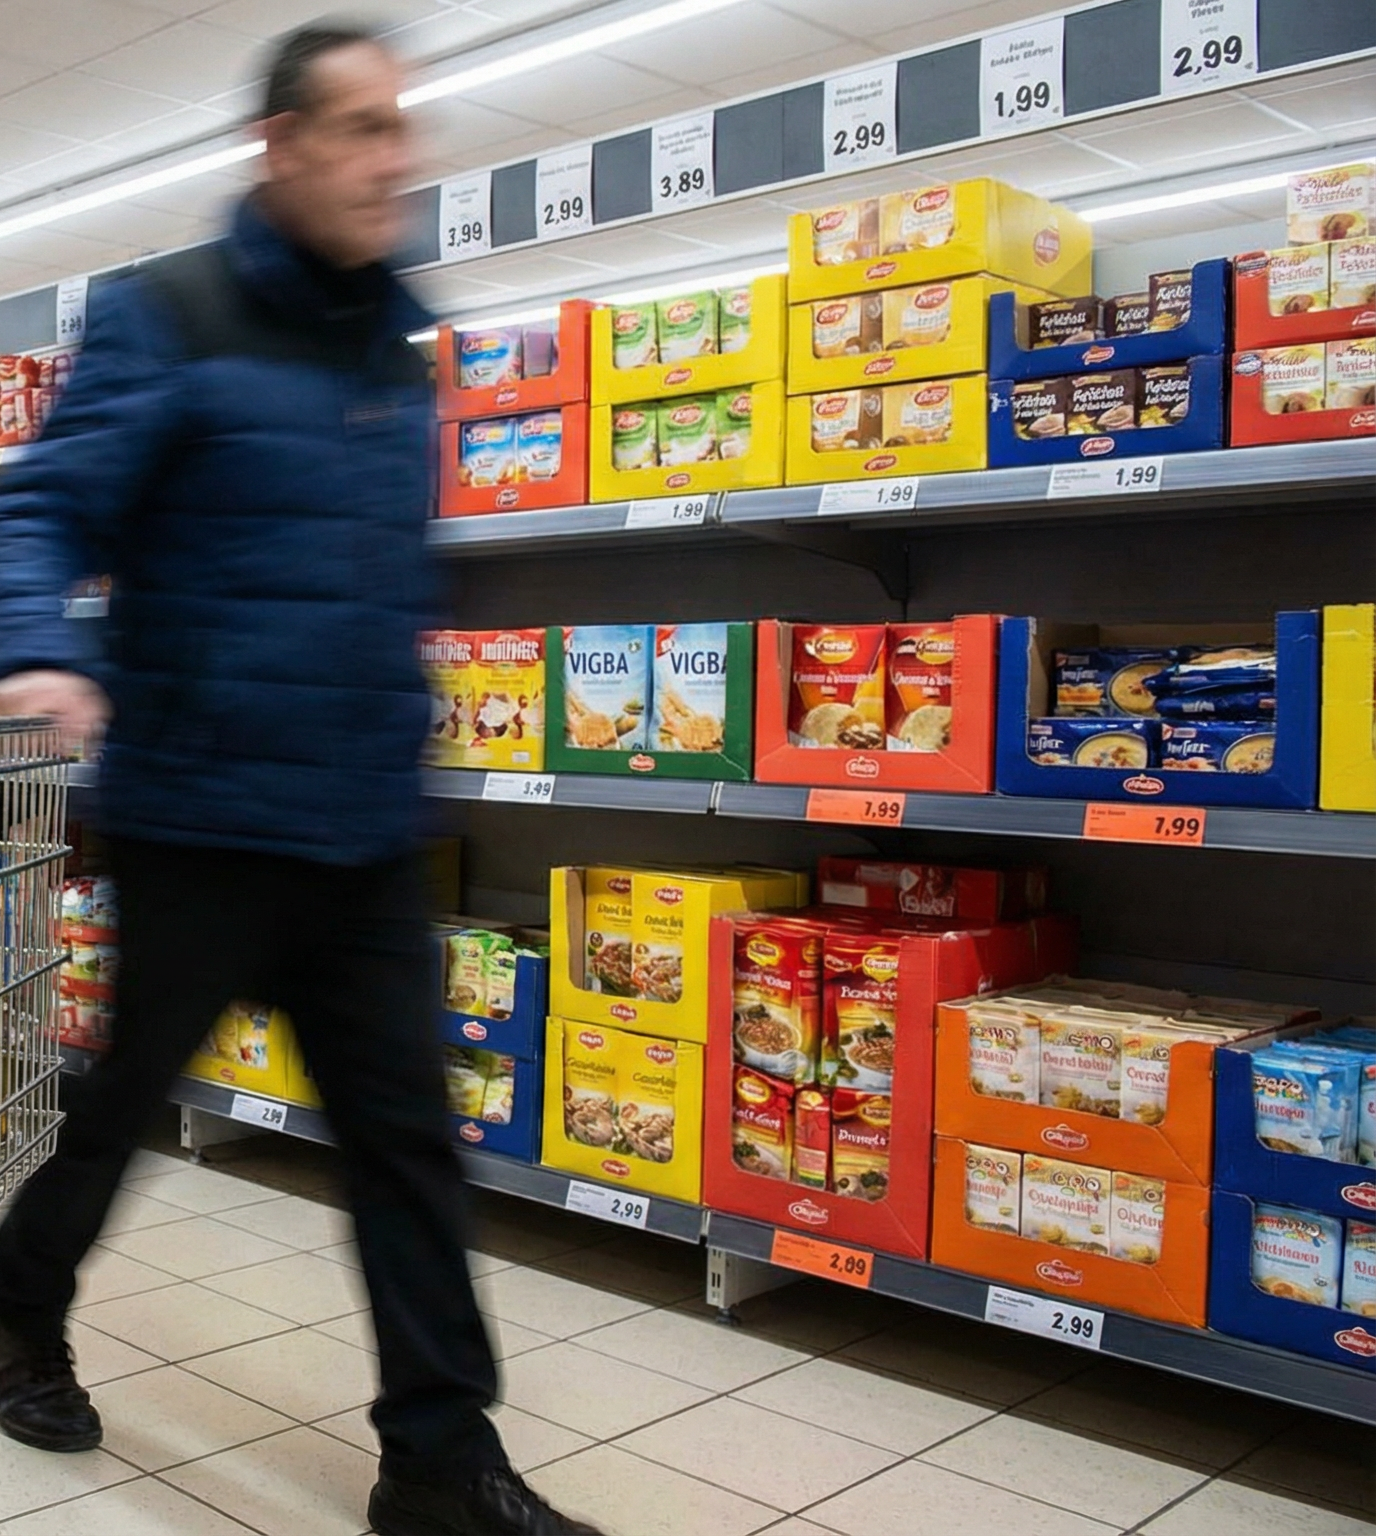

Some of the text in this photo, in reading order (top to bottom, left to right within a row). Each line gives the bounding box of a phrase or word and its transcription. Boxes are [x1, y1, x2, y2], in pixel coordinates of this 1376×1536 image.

[1173, 35, 1243, 77] 2,99
[994, 82, 1051, 118] 1,99
[833, 122, 886, 155] 2,99
[660, 168, 705, 198] 3,89
[544, 197, 584, 225] 2,99
[447, 222, 483, 247] 3,99
[569, 652, 629, 675] VIGBA
[611, 1198, 643, 1220] 2,99
[1051, 1312, 1094, 1338] 2,99
